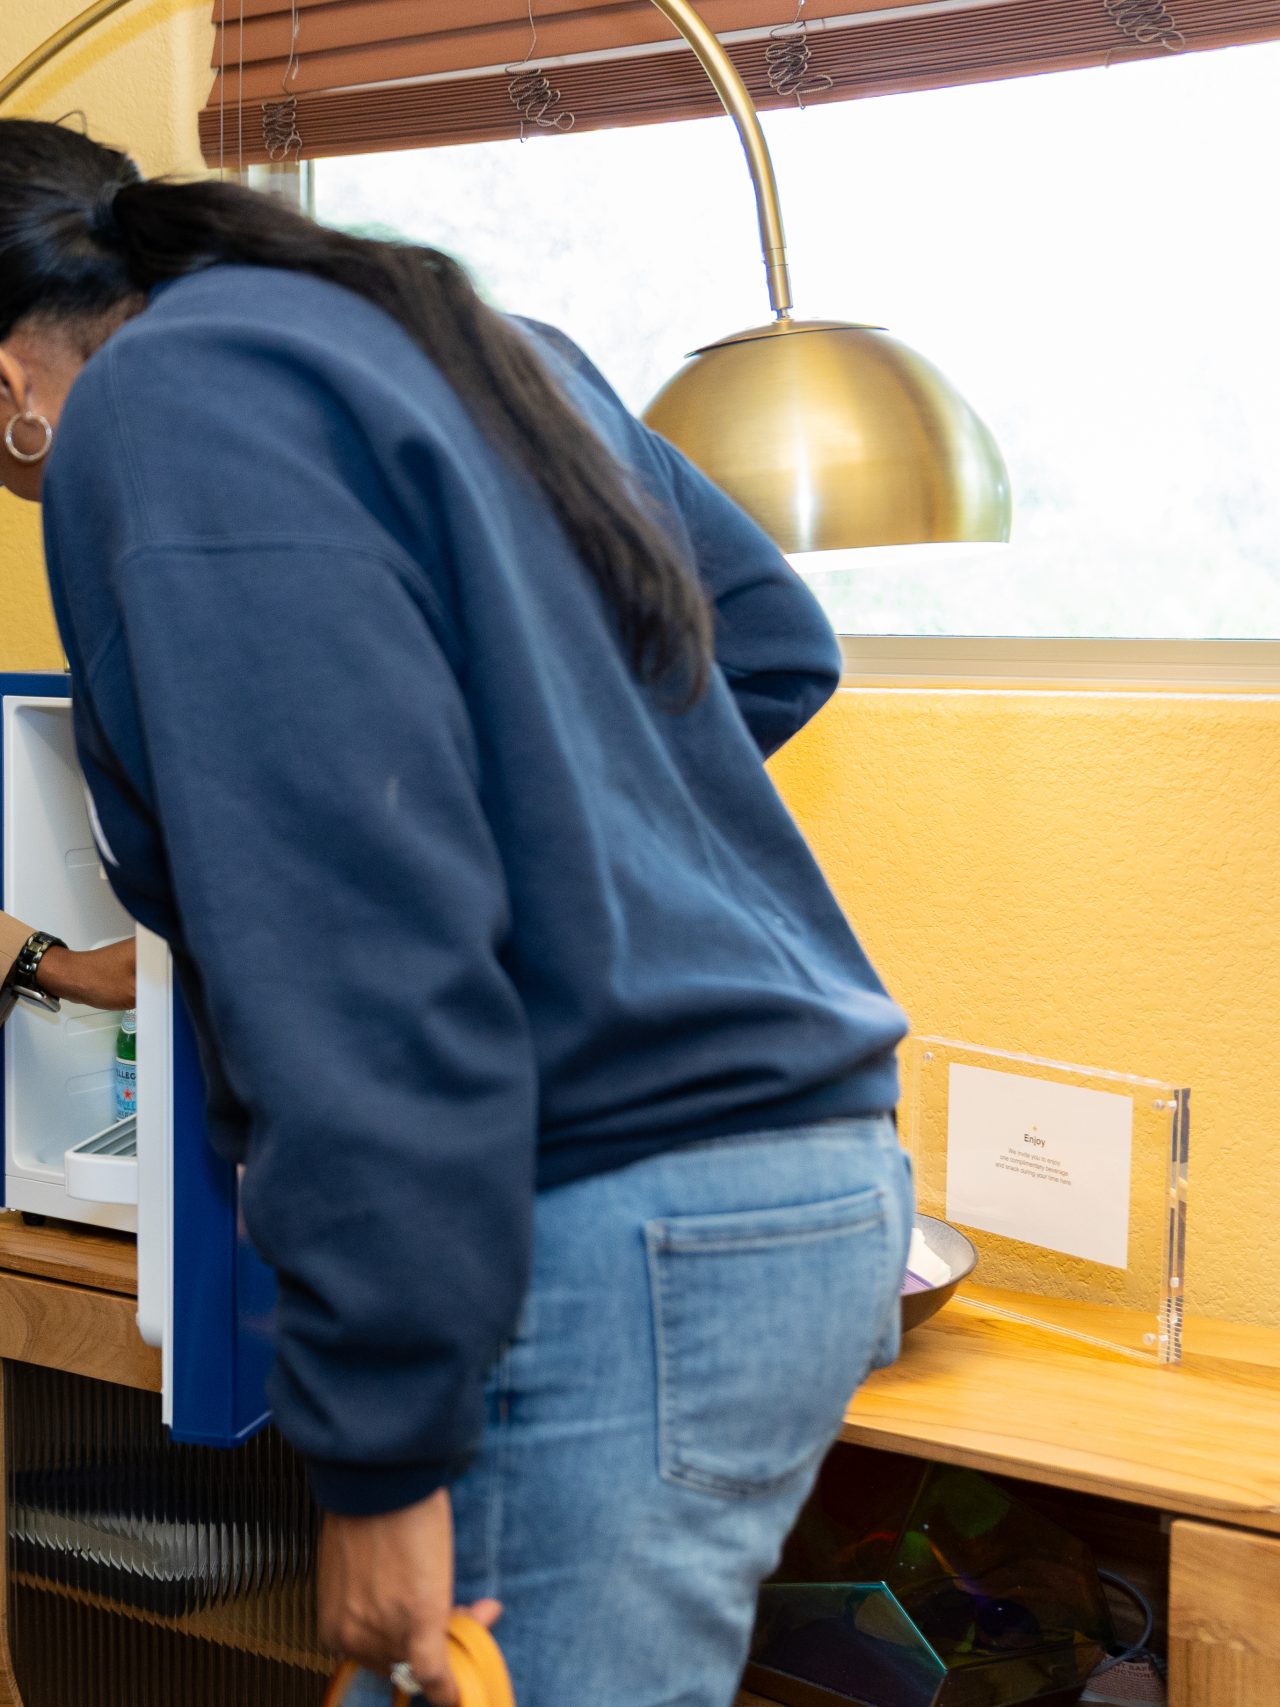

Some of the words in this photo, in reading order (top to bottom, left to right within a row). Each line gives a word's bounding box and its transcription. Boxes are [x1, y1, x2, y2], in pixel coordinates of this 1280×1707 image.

[1023, 1133, 1045, 1147] Enjoy
[1046, 1158, 1060, 1166] enjoy
[1020, 1168, 1035, 1177] during
